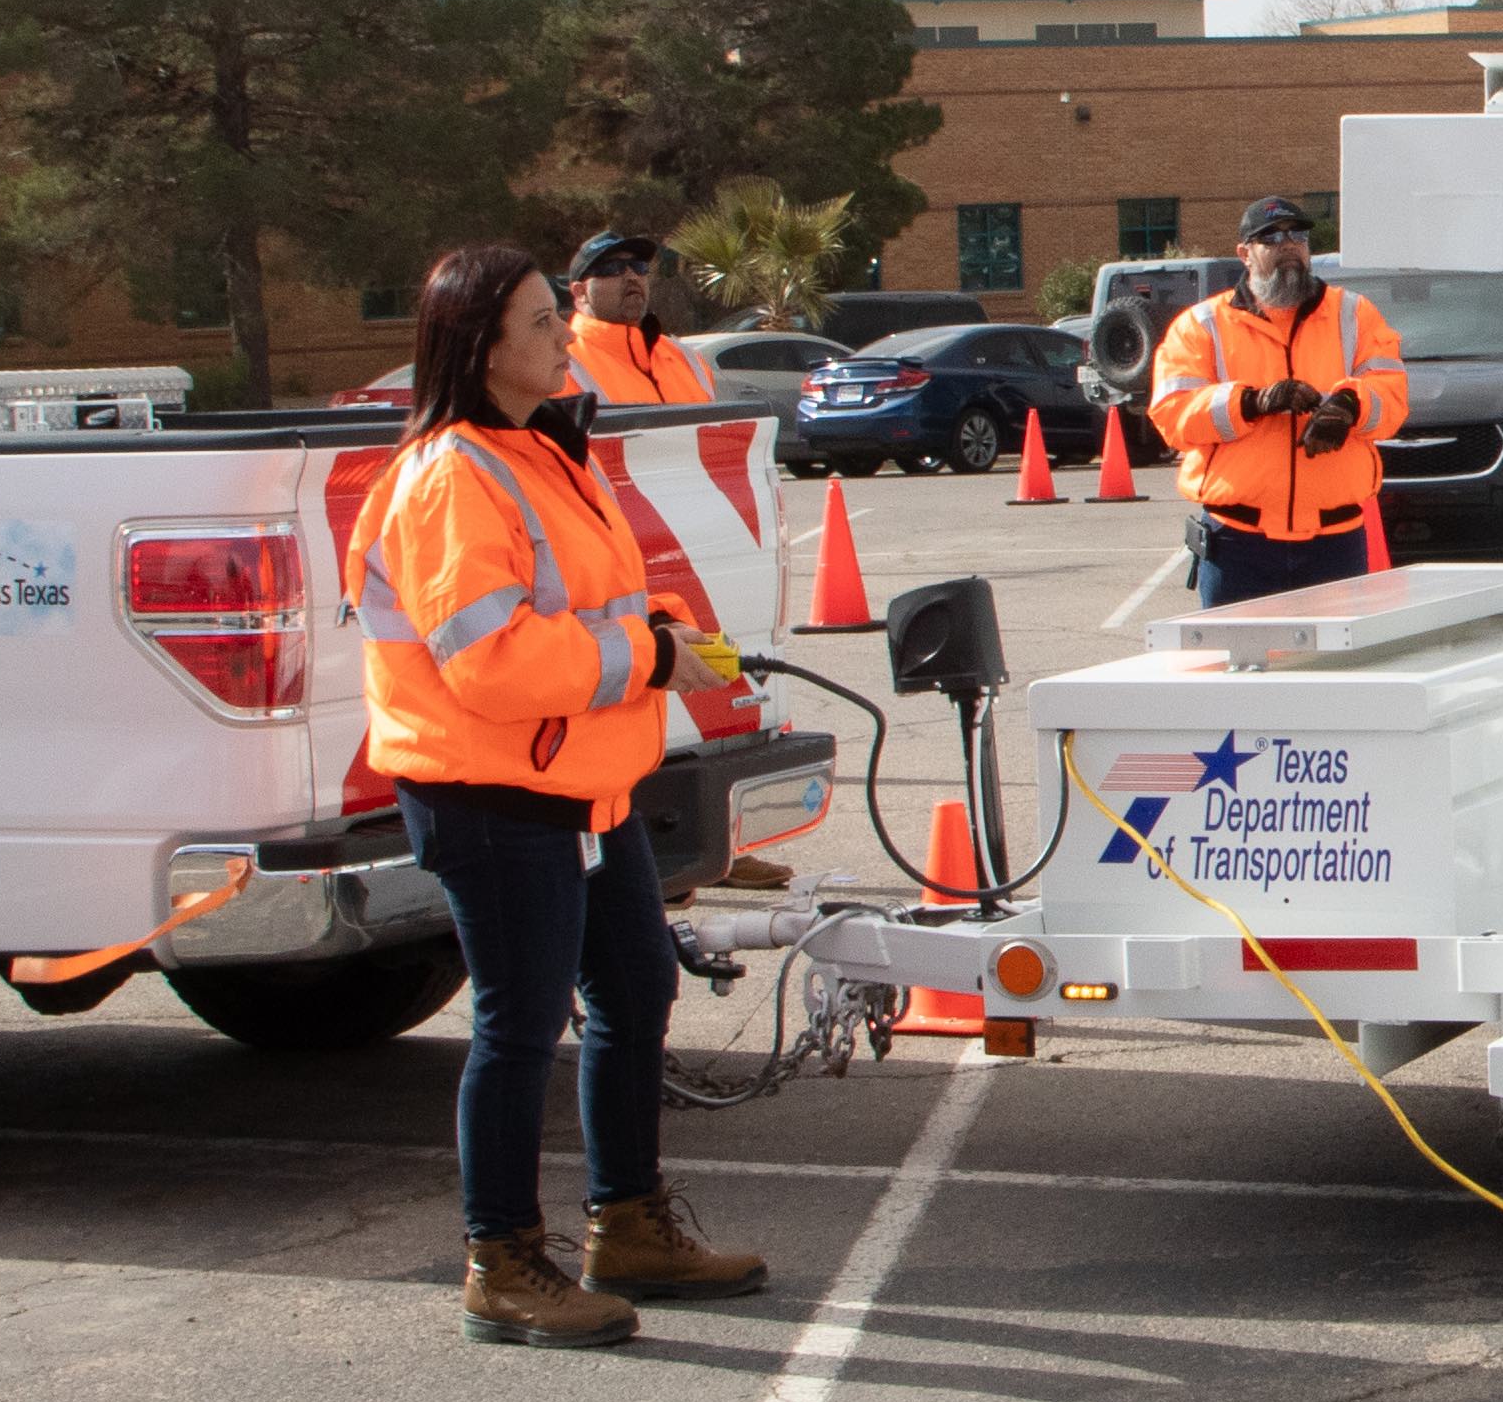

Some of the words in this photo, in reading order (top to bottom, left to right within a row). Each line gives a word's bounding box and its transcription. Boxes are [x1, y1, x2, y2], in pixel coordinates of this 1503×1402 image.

[15, 578, 71, 606] Texas
[1272, 739, 1348, 783] Texas
[1204, 788, 1371, 842] Department
[1146, 835, 1176, 880] of
[1190, 836, 1392, 892] Transportation
